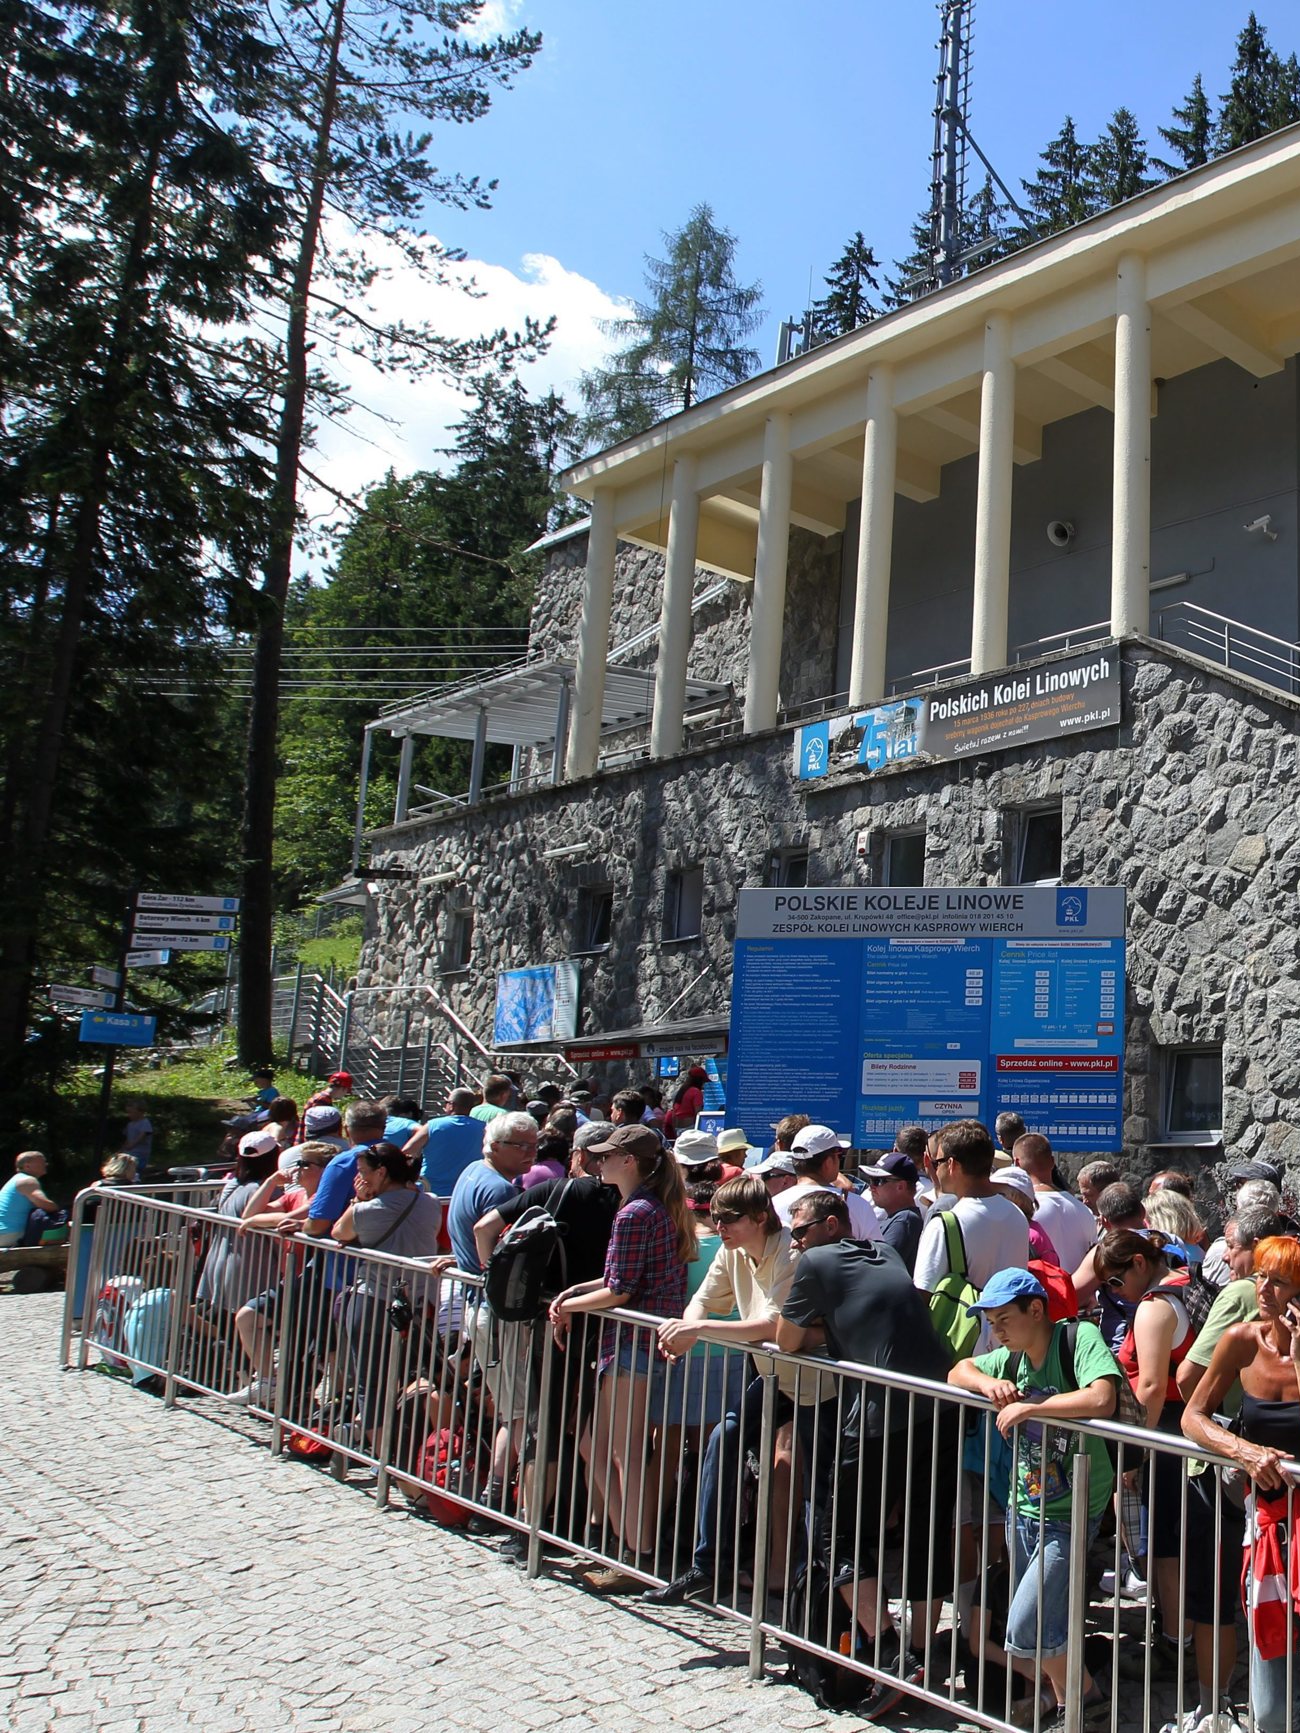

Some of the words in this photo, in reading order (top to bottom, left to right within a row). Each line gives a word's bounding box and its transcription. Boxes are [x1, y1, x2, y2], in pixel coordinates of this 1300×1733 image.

[930, 689, 988, 722] Polskich
[994, 677, 1031, 706] Kolei
[1036, 658, 1110, 695] Linowych
[954, 720, 961, 728] 15
[962, 716, 979, 727] marca
[980, 711, 994, 722] 1936
[996, 708, 1009, 719] roku
[1010, 707, 1018, 718] po
[1031, 699, 1050, 709] dniach
[1052, 692, 1075, 706] budowy
[1016, 716, 1023, 725] do
[1024, 708, 1060, 722] Kasprowego
[1061, 701, 1086, 714] Wierchu
[1060, 708, 1111, 728] www.pkl.pl
[854, 714, 888, 772] 75
[890, 732, 919, 761] lat
[981, 733, 1001, 744] razem
[1003, 730, 1007, 739] z
[808, 761, 820, 771] PKL
[775, 896, 858, 911] POLSKIE
[865, 895, 940, 910] KOLEJE
[946, 894, 1024, 910] LINOWE
[854, 913, 884, 922] Krupówki
[897, 913, 939, 921] office@pkl.pl
[943, 912, 968, 920] infolinia
[970, 912, 981, 920] 018
[983, 912, 994, 920] 201
[996, 912, 1004, 920] 45
[772, 922, 815, 933] ZESPÓŁ
[818, 924, 849, 932] KOLEI
[853, 923, 910, 932] LINOWYCH
[914, 923, 976, 932] KASPROWY
[979, 923, 1024, 932] WIERCH
[867, 945, 886, 954] Kolej
[914, 945, 952, 953] Kasprowy
[106, 1016, 130, 1026] Kasa
[131, 1019, 138, 1027] 3
[1000, 1059, 1036, 1068] Sprzedaż
[1070, 1060, 1113, 1068] www.pkl.pl
